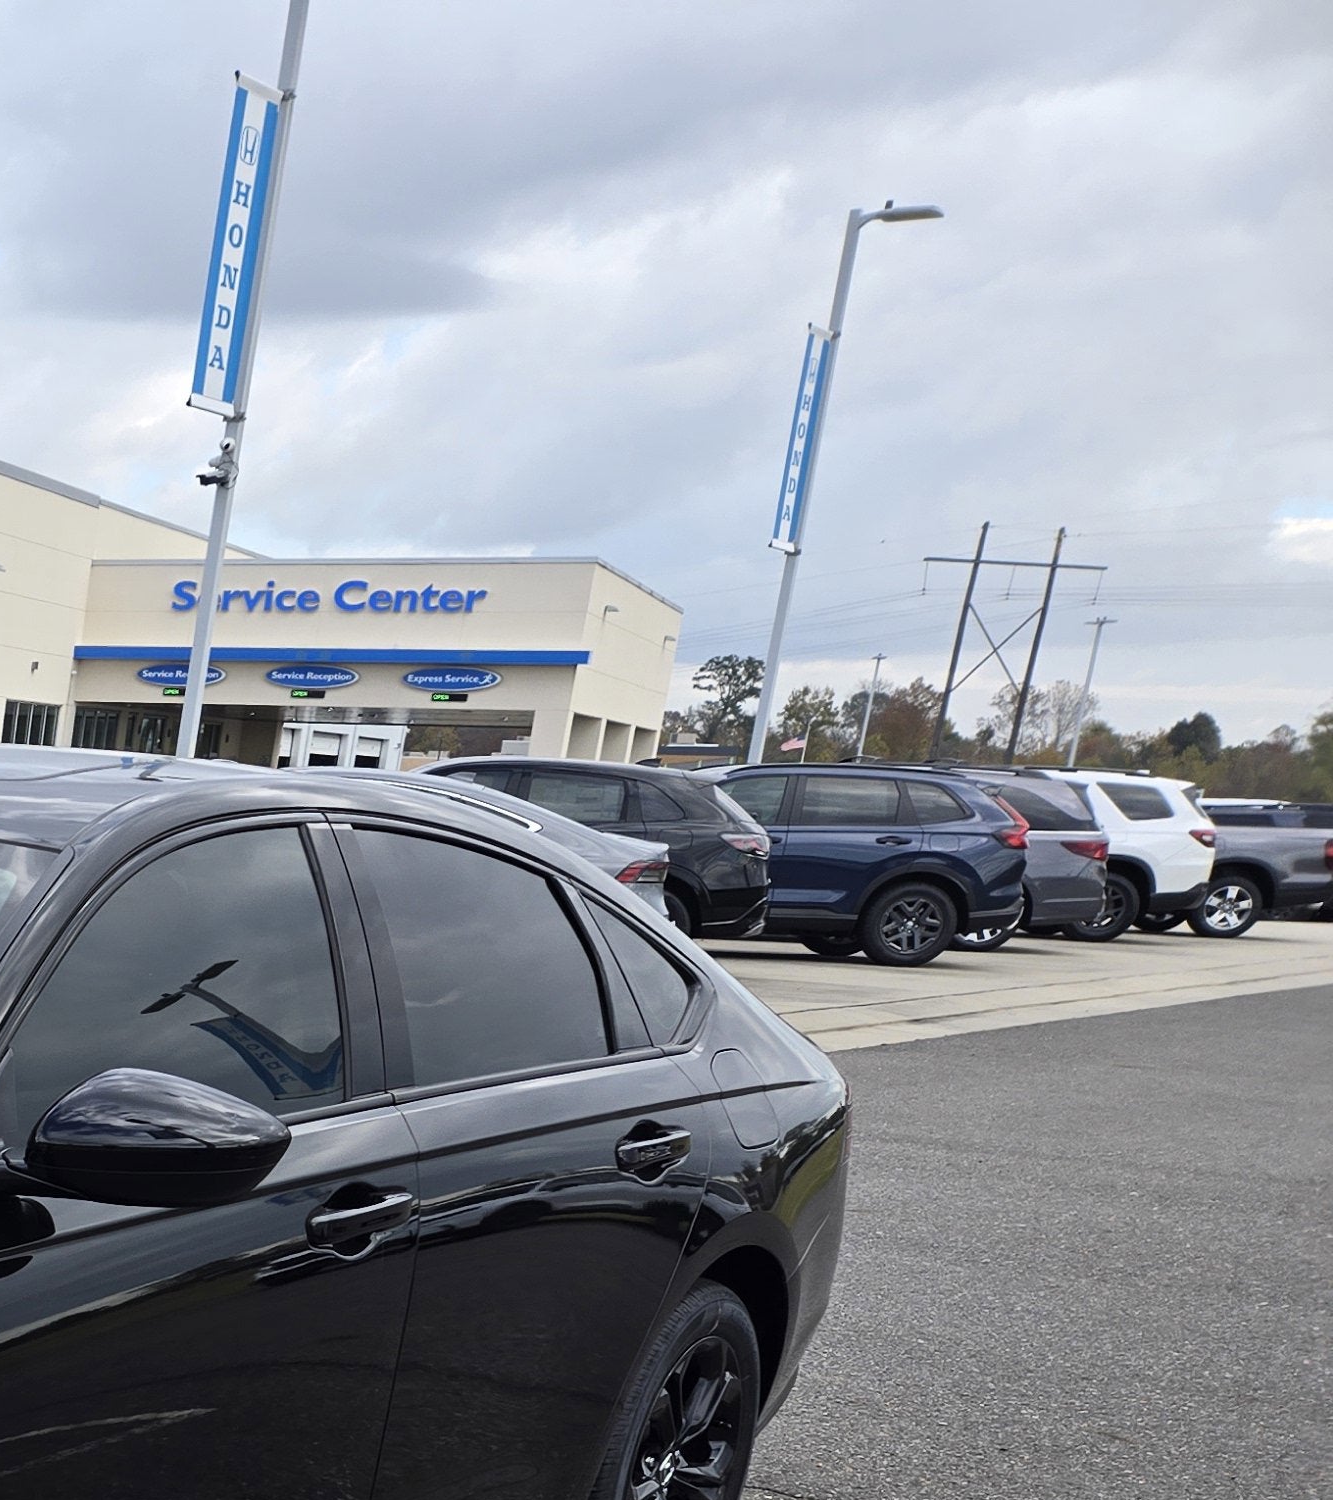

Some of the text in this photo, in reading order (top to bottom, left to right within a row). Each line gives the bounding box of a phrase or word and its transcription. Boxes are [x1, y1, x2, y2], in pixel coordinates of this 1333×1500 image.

[209, 180, 251, 371] HONDA
[783, 394, 811, 521] HONDA
[172, 580, 488, 613] Srvice Center
[142, 670, 173, 678] Service
[271, 671, 352, 682] Service Reception
[407, 674, 479, 684] Express Service
